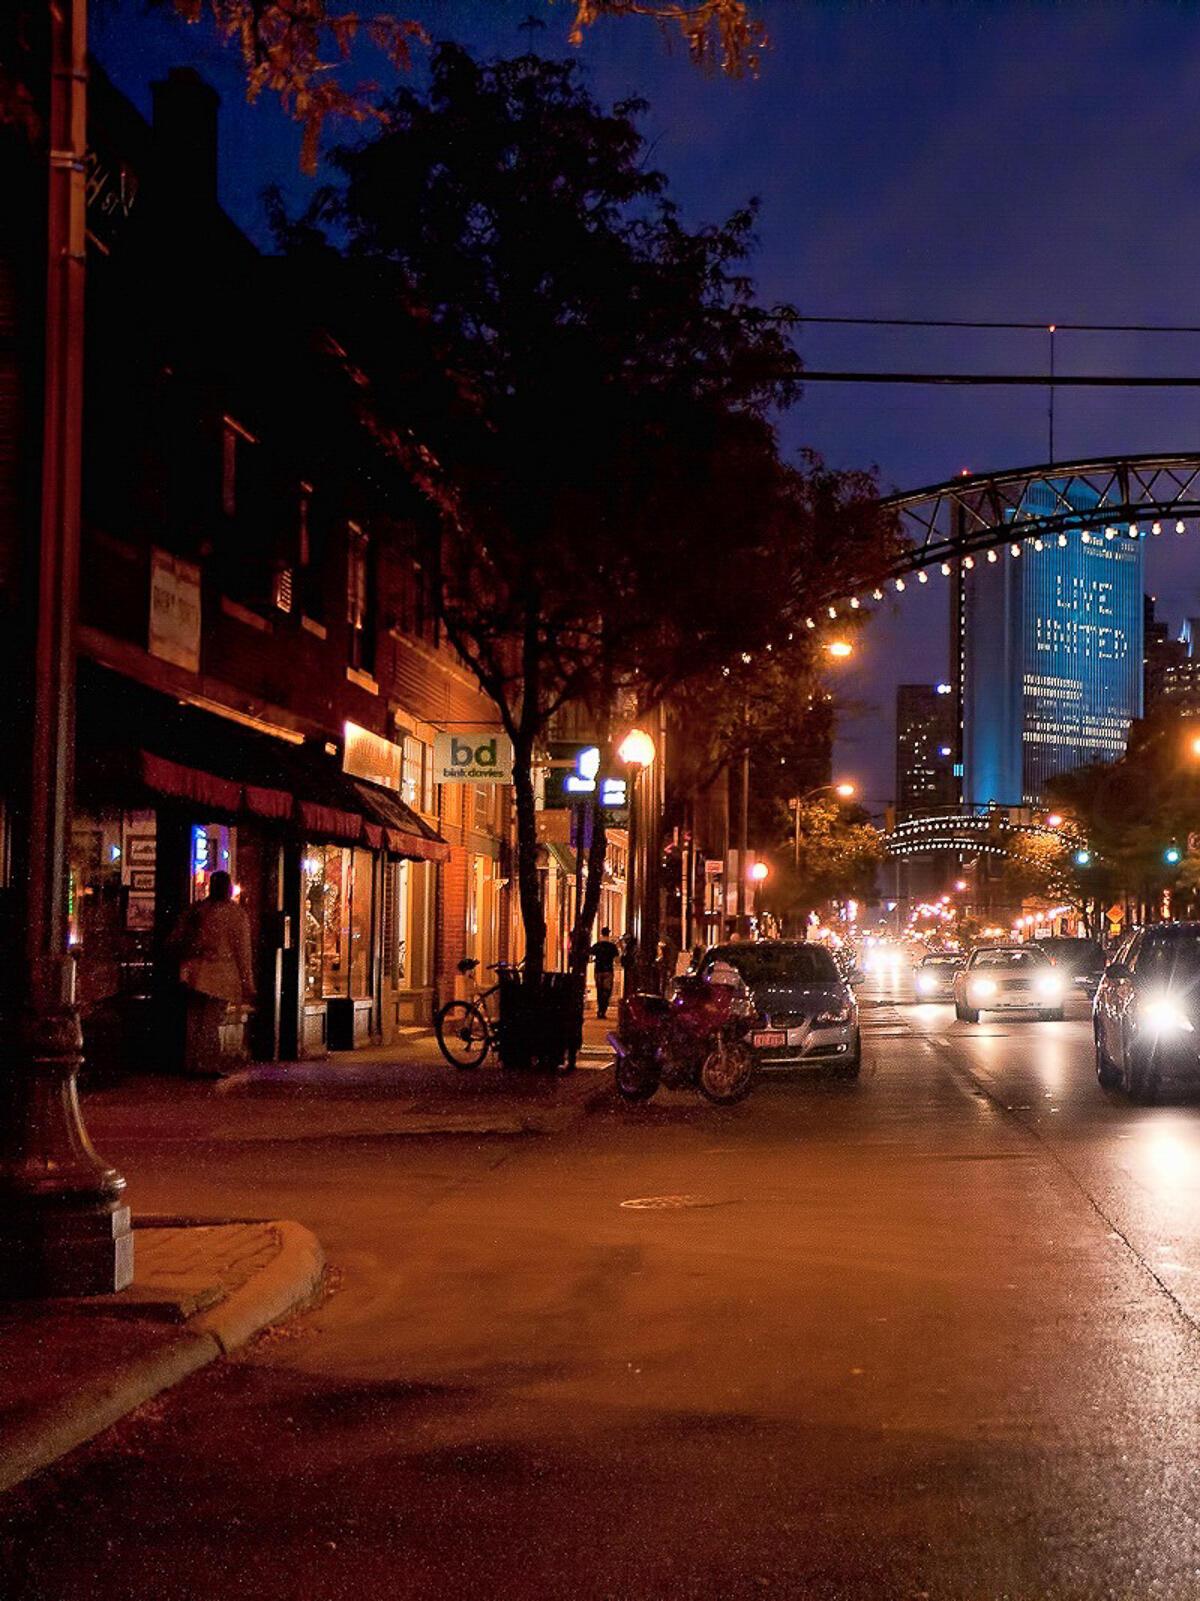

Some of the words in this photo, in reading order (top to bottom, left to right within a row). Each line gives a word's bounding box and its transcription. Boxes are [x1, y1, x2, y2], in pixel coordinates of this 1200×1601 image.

[1056, 575, 1113, 616] LIVE
[1037, 617, 1128, 659] UNITED
[451, 738, 497, 766] bd
